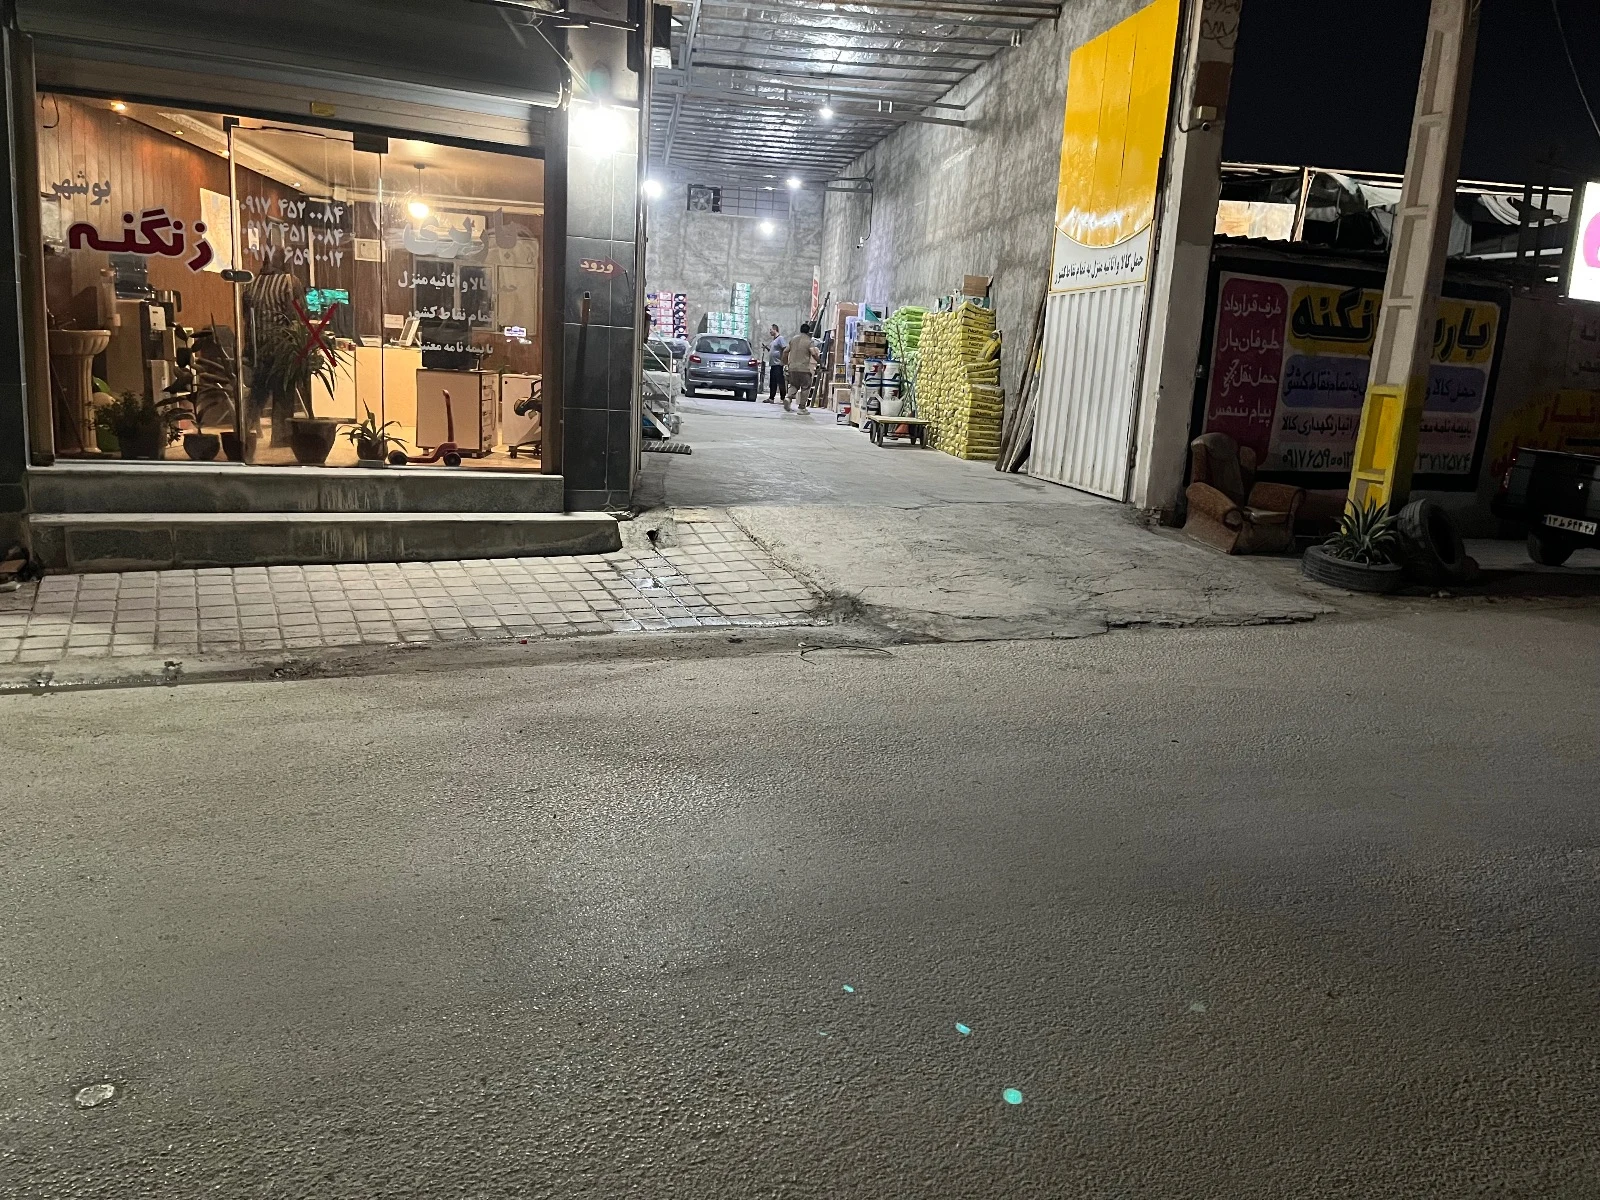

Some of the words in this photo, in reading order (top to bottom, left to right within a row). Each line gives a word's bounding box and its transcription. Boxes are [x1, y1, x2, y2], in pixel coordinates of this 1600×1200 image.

[51, 171, 111, 205] بوشهر
[67, 208, 214, 272] زنگنه
[580, 261, 614, 274] ورود
[397, 270, 429, 290] منزل
[1224, 293, 1258, 317] قرارداد
[1258, 296, 1281, 319] طرف
[1292, 287, 1375, 343] نگنه
